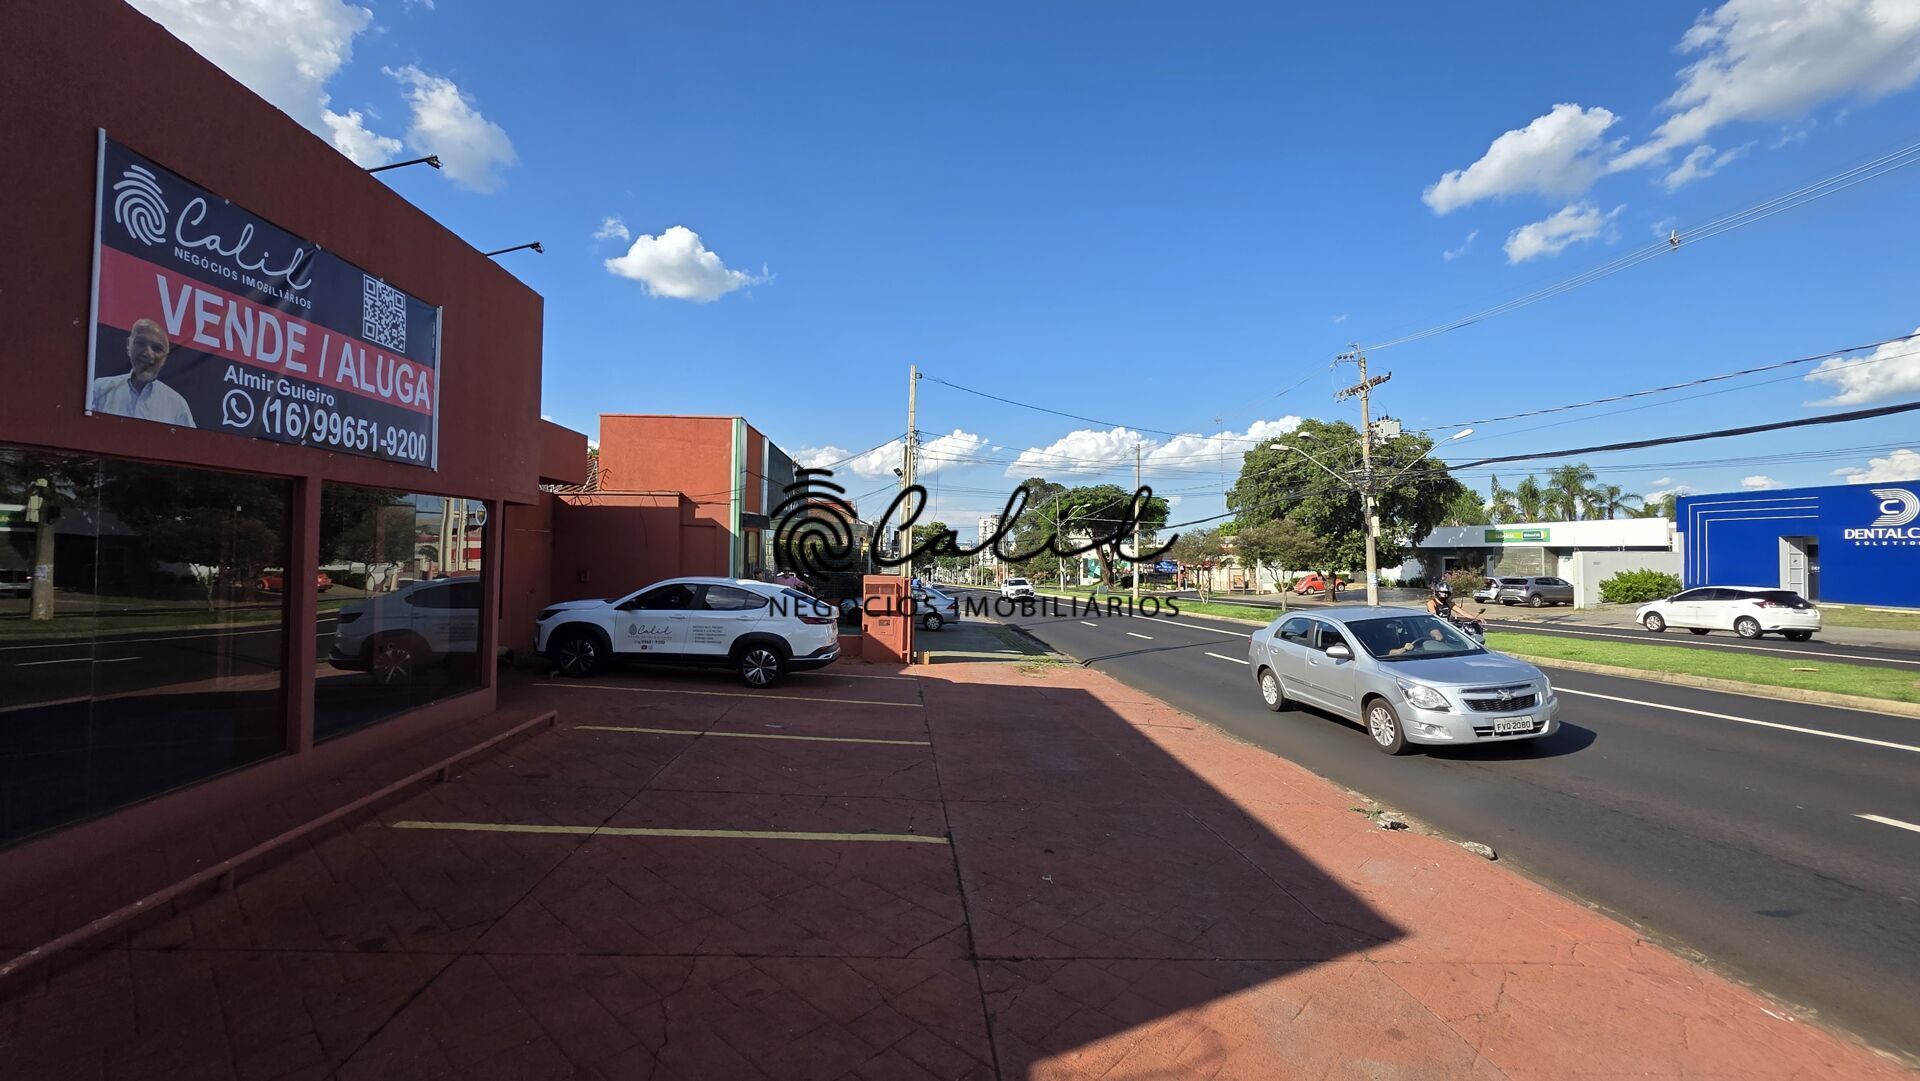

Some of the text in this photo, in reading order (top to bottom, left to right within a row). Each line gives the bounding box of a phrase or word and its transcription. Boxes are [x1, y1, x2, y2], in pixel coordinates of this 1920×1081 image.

[174, 247, 312, 310] NEGÓCIOS IMOBILIÁRIOS
[175, 197, 312, 290] Calil
[156, 274, 308, 374] VENDE
[336, 341, 431, 409] ALUGA
[223, 365, 335, 406] Almir Guieiro
